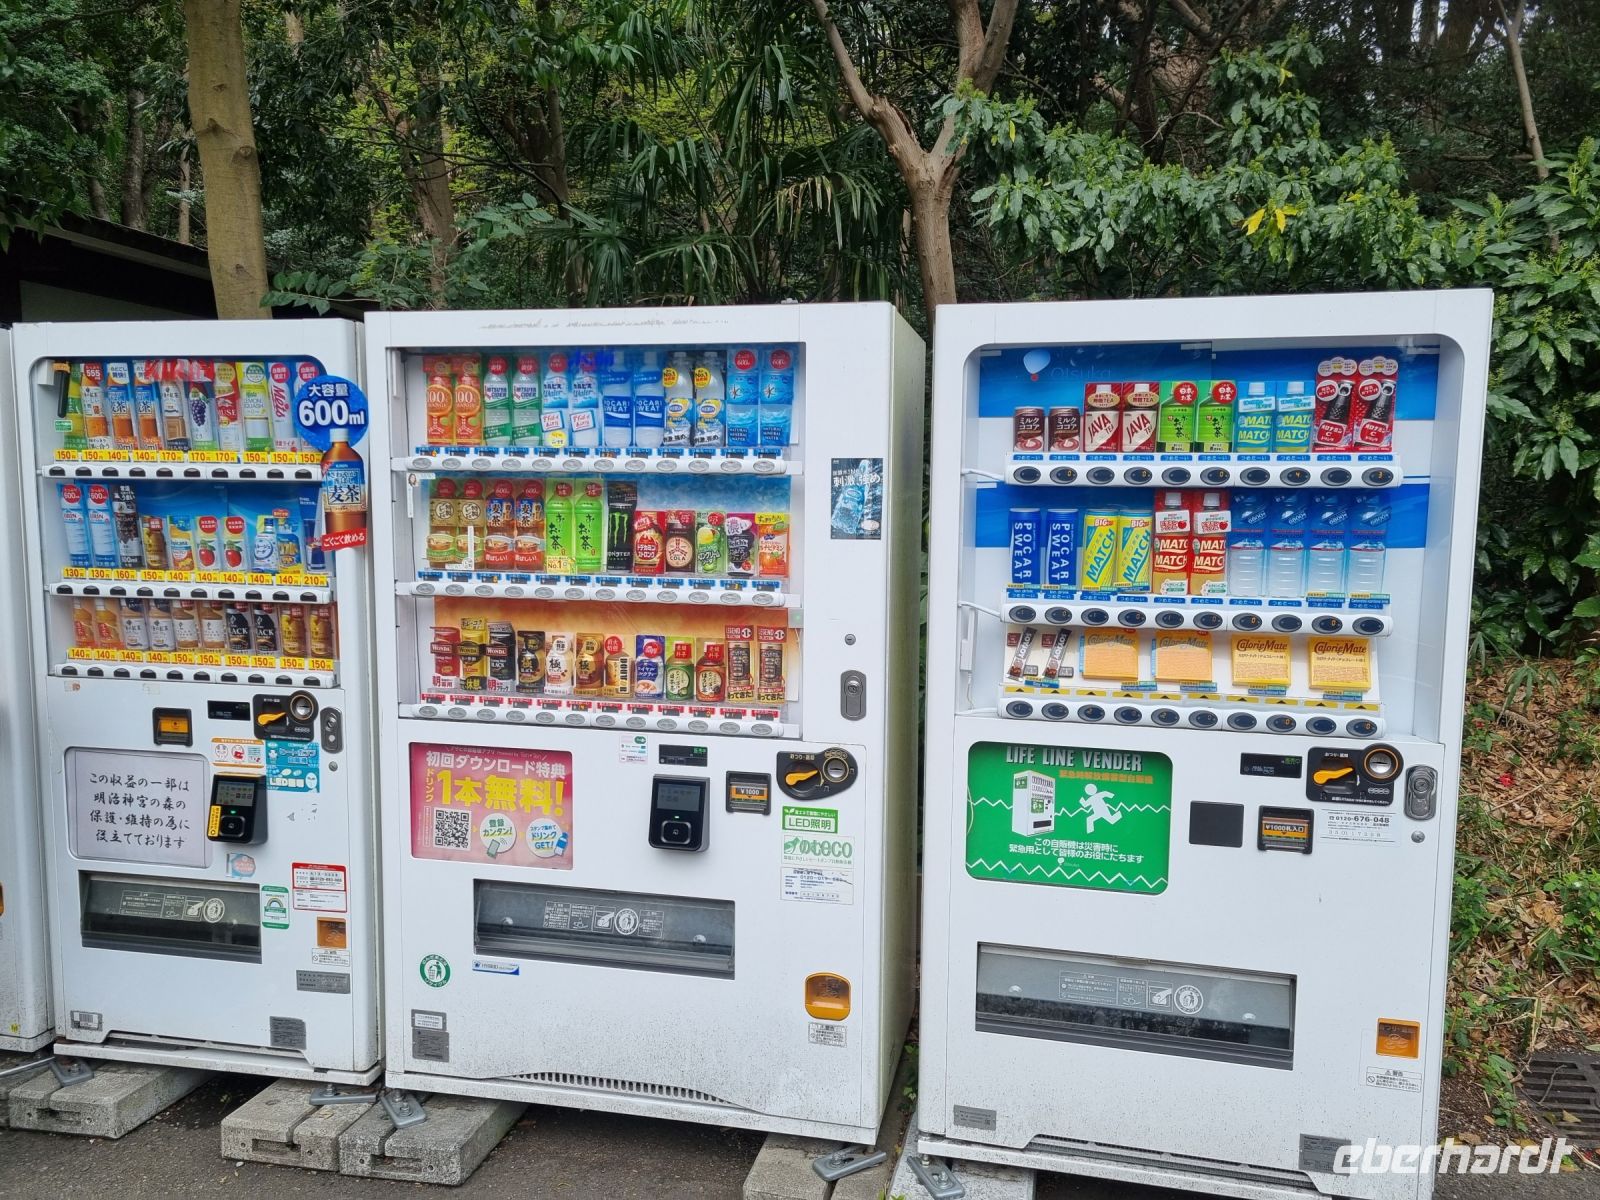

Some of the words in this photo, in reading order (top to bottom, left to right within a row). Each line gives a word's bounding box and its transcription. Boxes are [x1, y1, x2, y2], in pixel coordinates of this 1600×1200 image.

[308, 383, 349, 397] 大容量
[299, 400, 365, 426] 600ml
[1088, 413, 1111, 443] JAVA
[1126, 413, 1150, 444] JAVA
[329, 485, 360, 503] 麦茶
[1094, 518, 1108, 527] BIG
[1131, 519, 1145, 527] BIG
[323, 532, 365, 547] ごくごく飲める
[1014, 522, 1023, 579] SWEAT
[1051, 523, 1061, 580] SWEAT
[1086, 528, 1116, 583] MATCH
[1122, 529, 1152, 582] MATCH
[1236, 638, 1289, 652] CalorieMate
[1313, 641, 1368, 655] CalorieMate
[426, 750, 567, 779] 初回ダウンロード特典
[1006, 746, 1035, 764] LIFE
[1042, 748, 1074, 767] LINE
[1082, 750, 1143, 772] VENDER
[89, 772, 190, 792] この収益の一部は
[425, 768, 434, 802] ドリンク
[93, 791, 187, 811] 明治神宮の森の
[436, 769, 566, 817] 1本無料!
[89, 809, 191, 831] 保護・維持の為に
[488, 818, 505, 827] 登録
[788, 817, 832, 830] LED照明
[1335, 815, 1390, 824] 0120-676-048
[95, 829, 185, 849] 役立てております
[482, 826, 513, 838] カンタン!
[531, 831, 557, 841] ドリンク
[534, 840, 554, 850] GET!
[1009, 844, 1145, 864] 緊急用として皆様のお役にたちます
[1034, 838, 1119, 853] この自販機は災害時に
